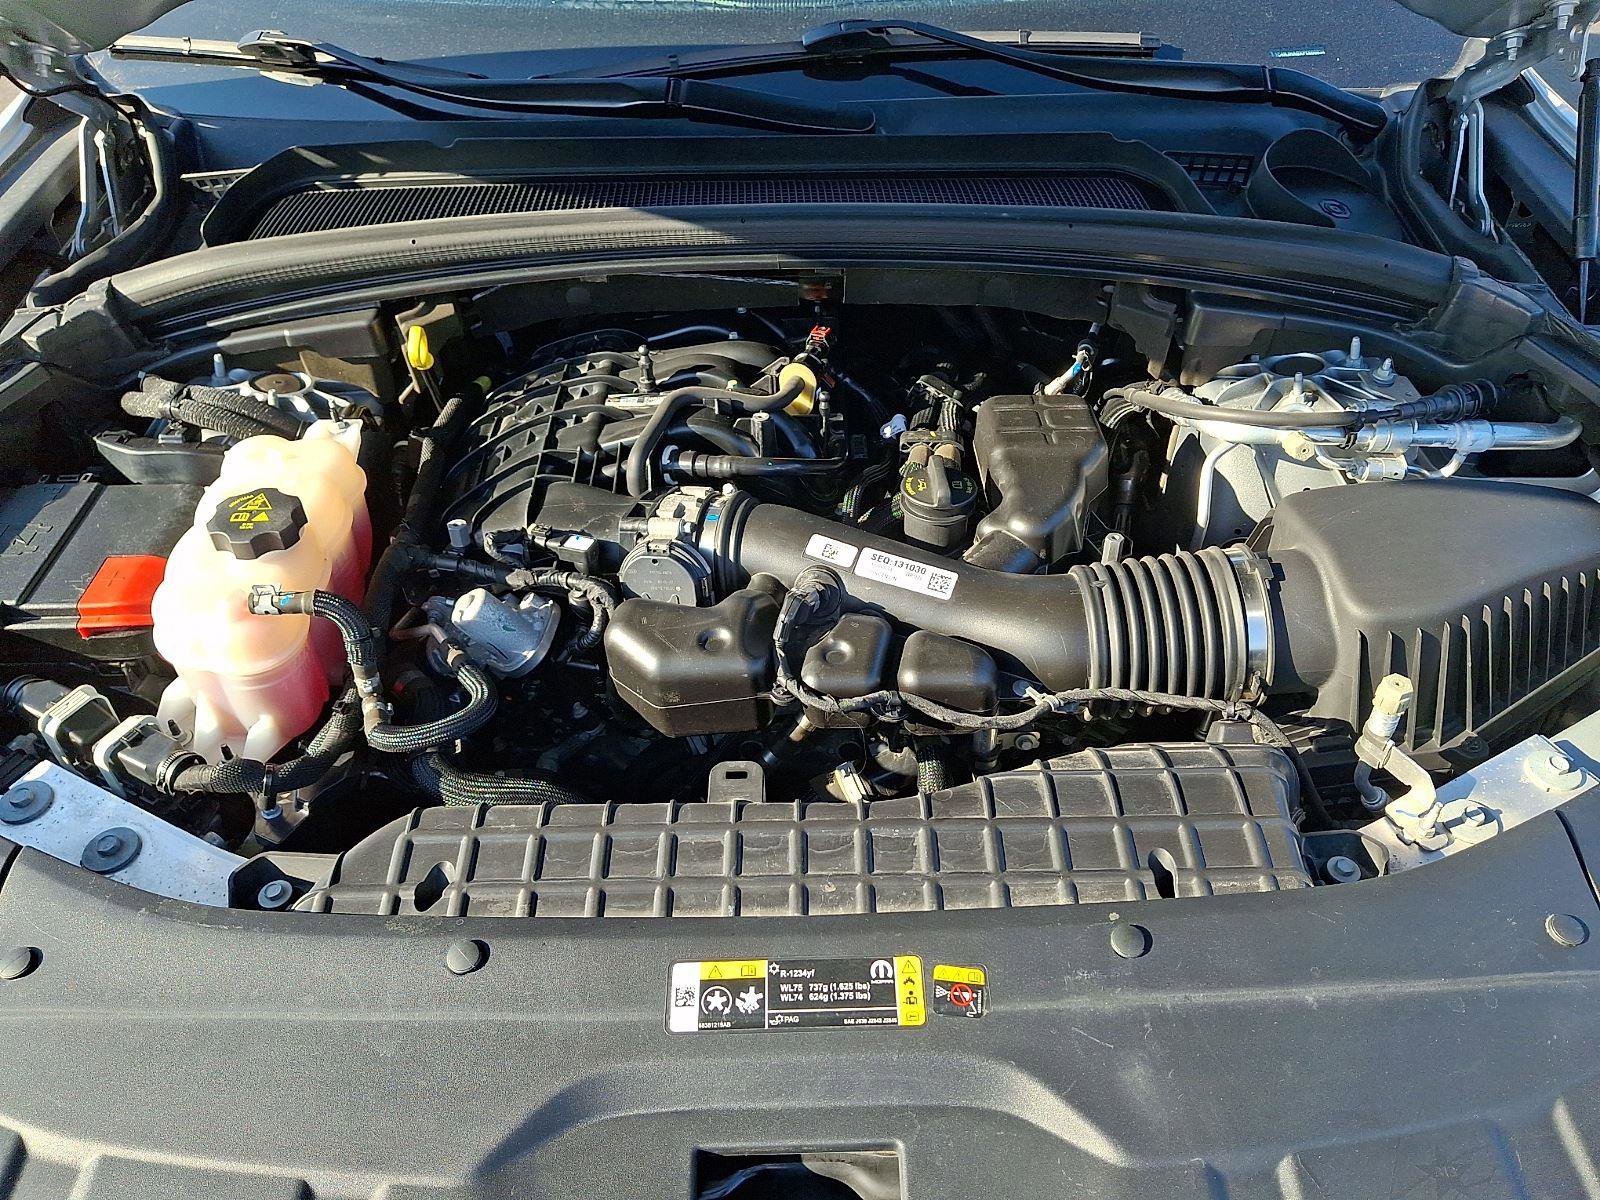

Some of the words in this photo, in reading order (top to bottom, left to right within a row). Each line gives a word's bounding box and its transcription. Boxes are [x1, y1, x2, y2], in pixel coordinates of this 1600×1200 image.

[871, 553, 927, 575] SEQ:131030
[780, 968, 815, 979] R-1234yf
[780, 983, 803, 993] WL75
[809, 983, 829, 993] 737g
[780, 993, 804, 1002] WL74
[784, 1015, 800, 1023] PAG
